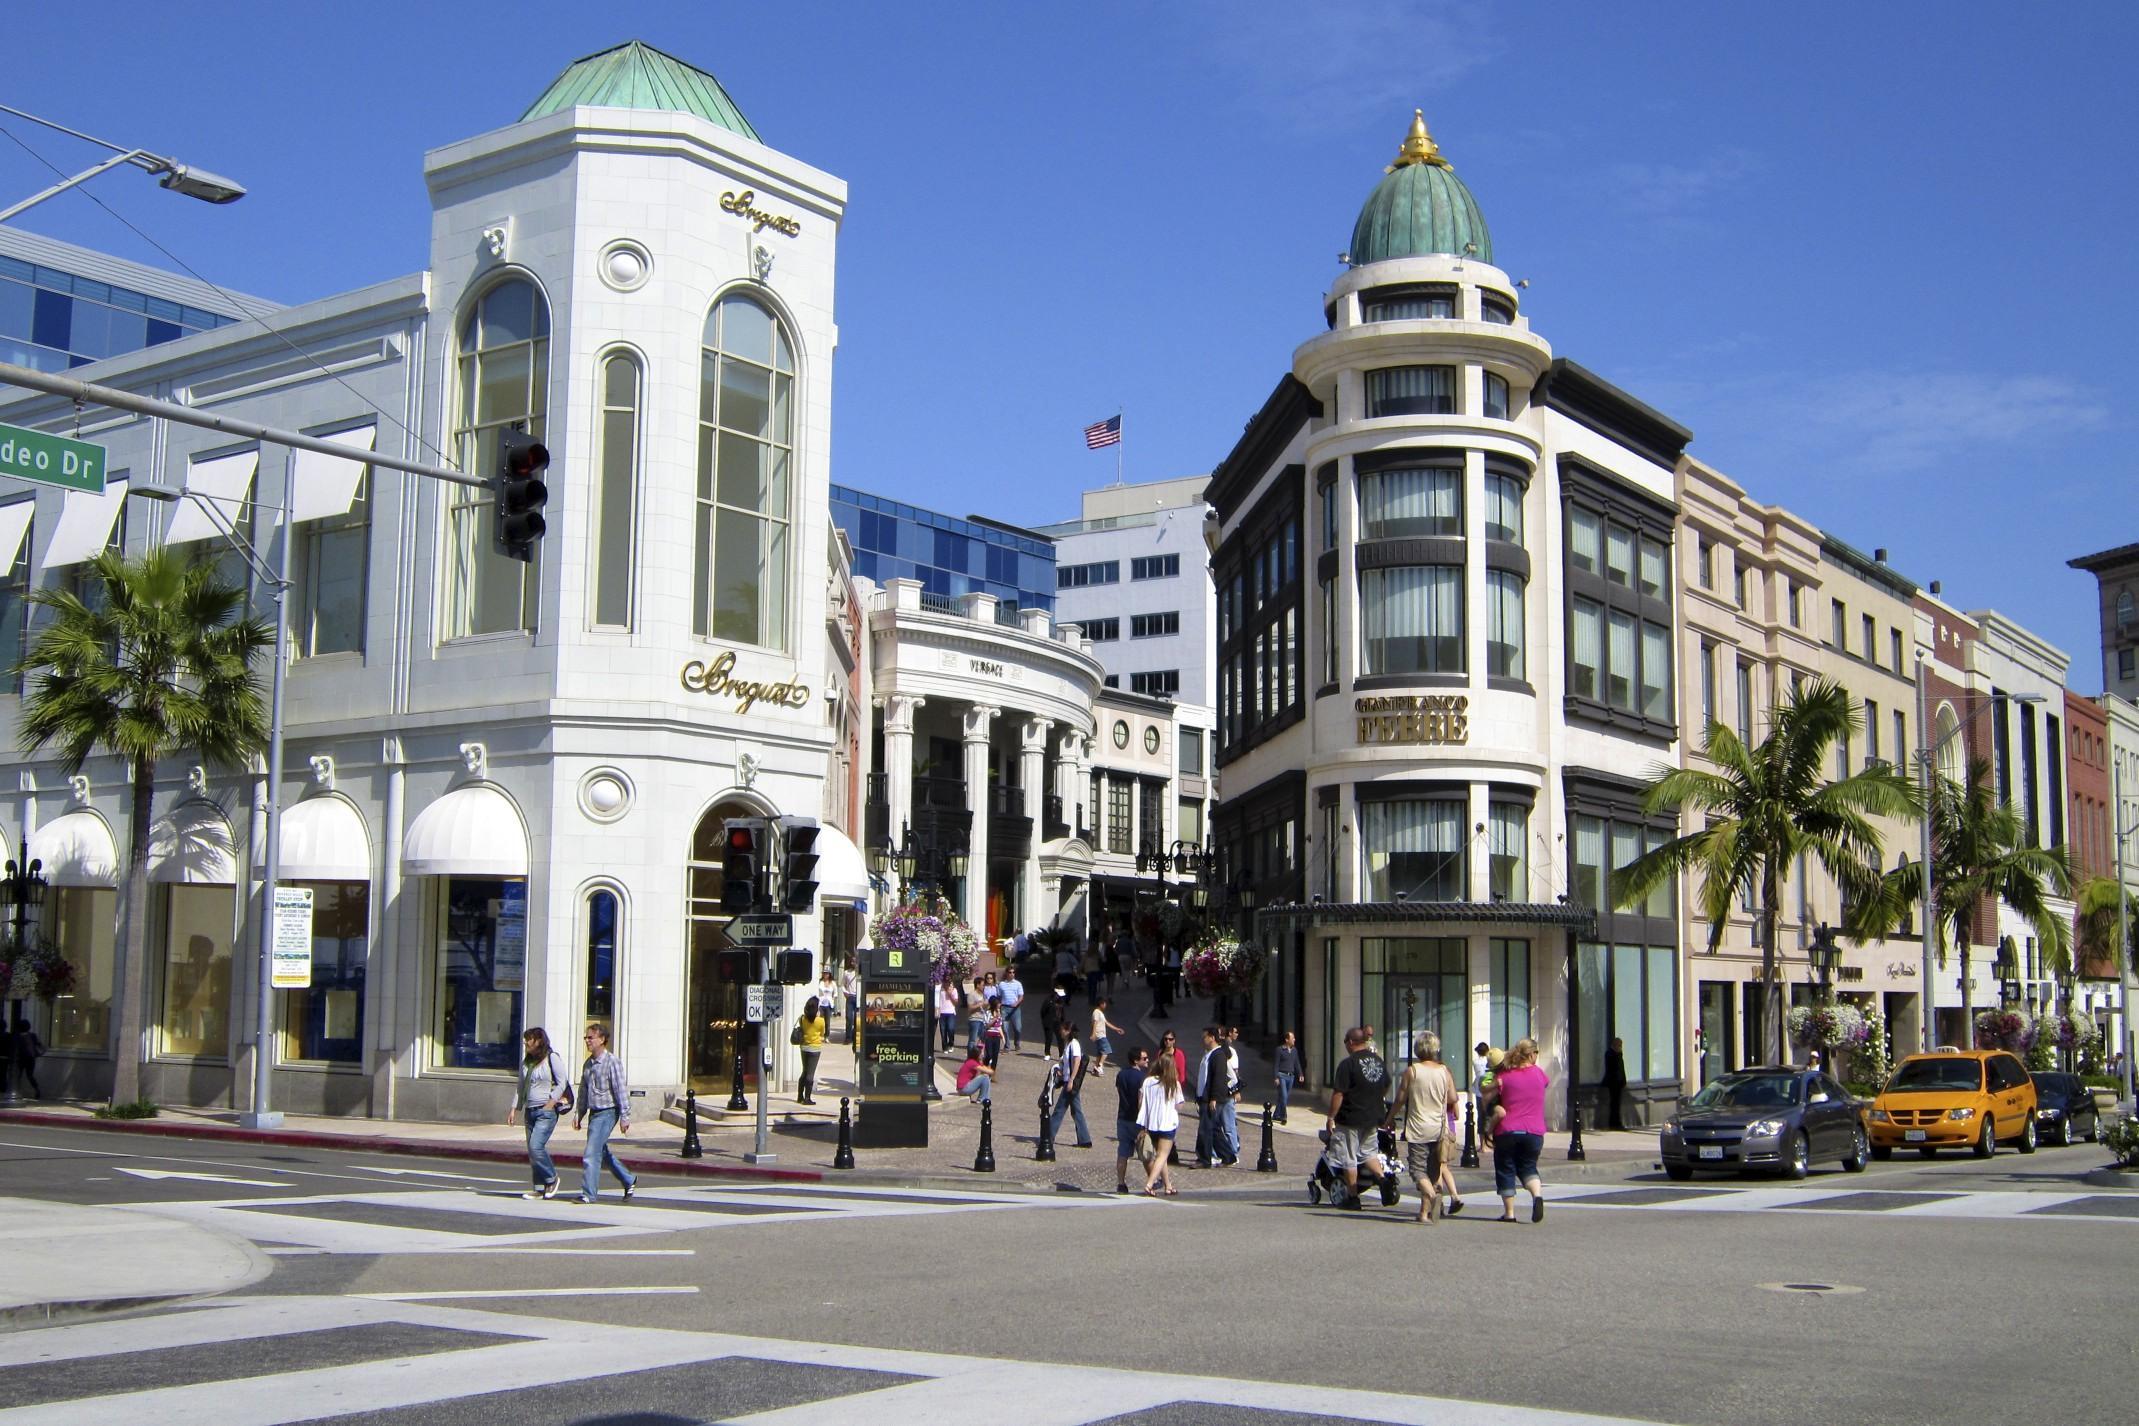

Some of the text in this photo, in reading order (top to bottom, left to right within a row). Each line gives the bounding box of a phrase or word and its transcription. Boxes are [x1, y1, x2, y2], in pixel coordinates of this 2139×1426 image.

[63, 450, 93, 478] Dr
[969, 660, 1003, 677] VERSACE
[680, 651, 809, 714] Breguet
[1355, 695, 1468, 712] GIANFRANCO
[1357, 715, 1468, 743] FERRE
[742, 925, 784, 936] ONE WAY
[749, 1006, 761, 1018] OK
[876, 1044, 897, 1055] free
[879, 1050, 919, 1064] parking
